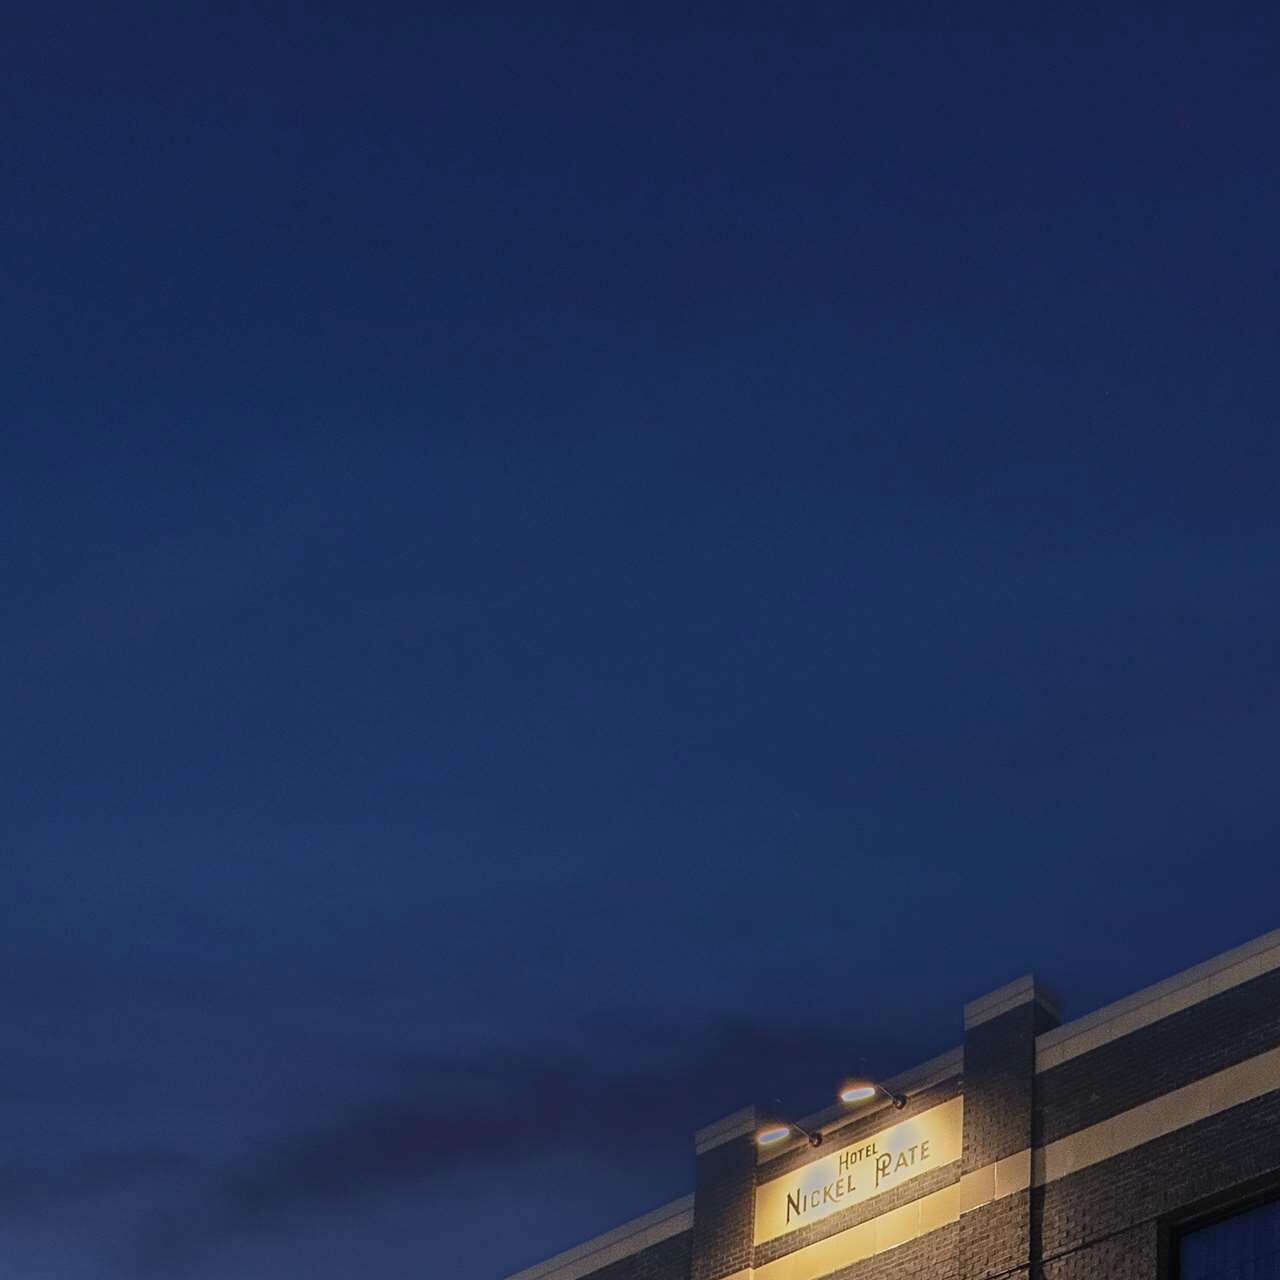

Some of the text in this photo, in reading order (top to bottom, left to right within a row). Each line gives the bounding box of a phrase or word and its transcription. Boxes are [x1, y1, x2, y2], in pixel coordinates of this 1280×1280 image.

[785, 1140, 930, 1225] NICKEL PLATE
[839, 1143, 877, 1178] HOTEL
